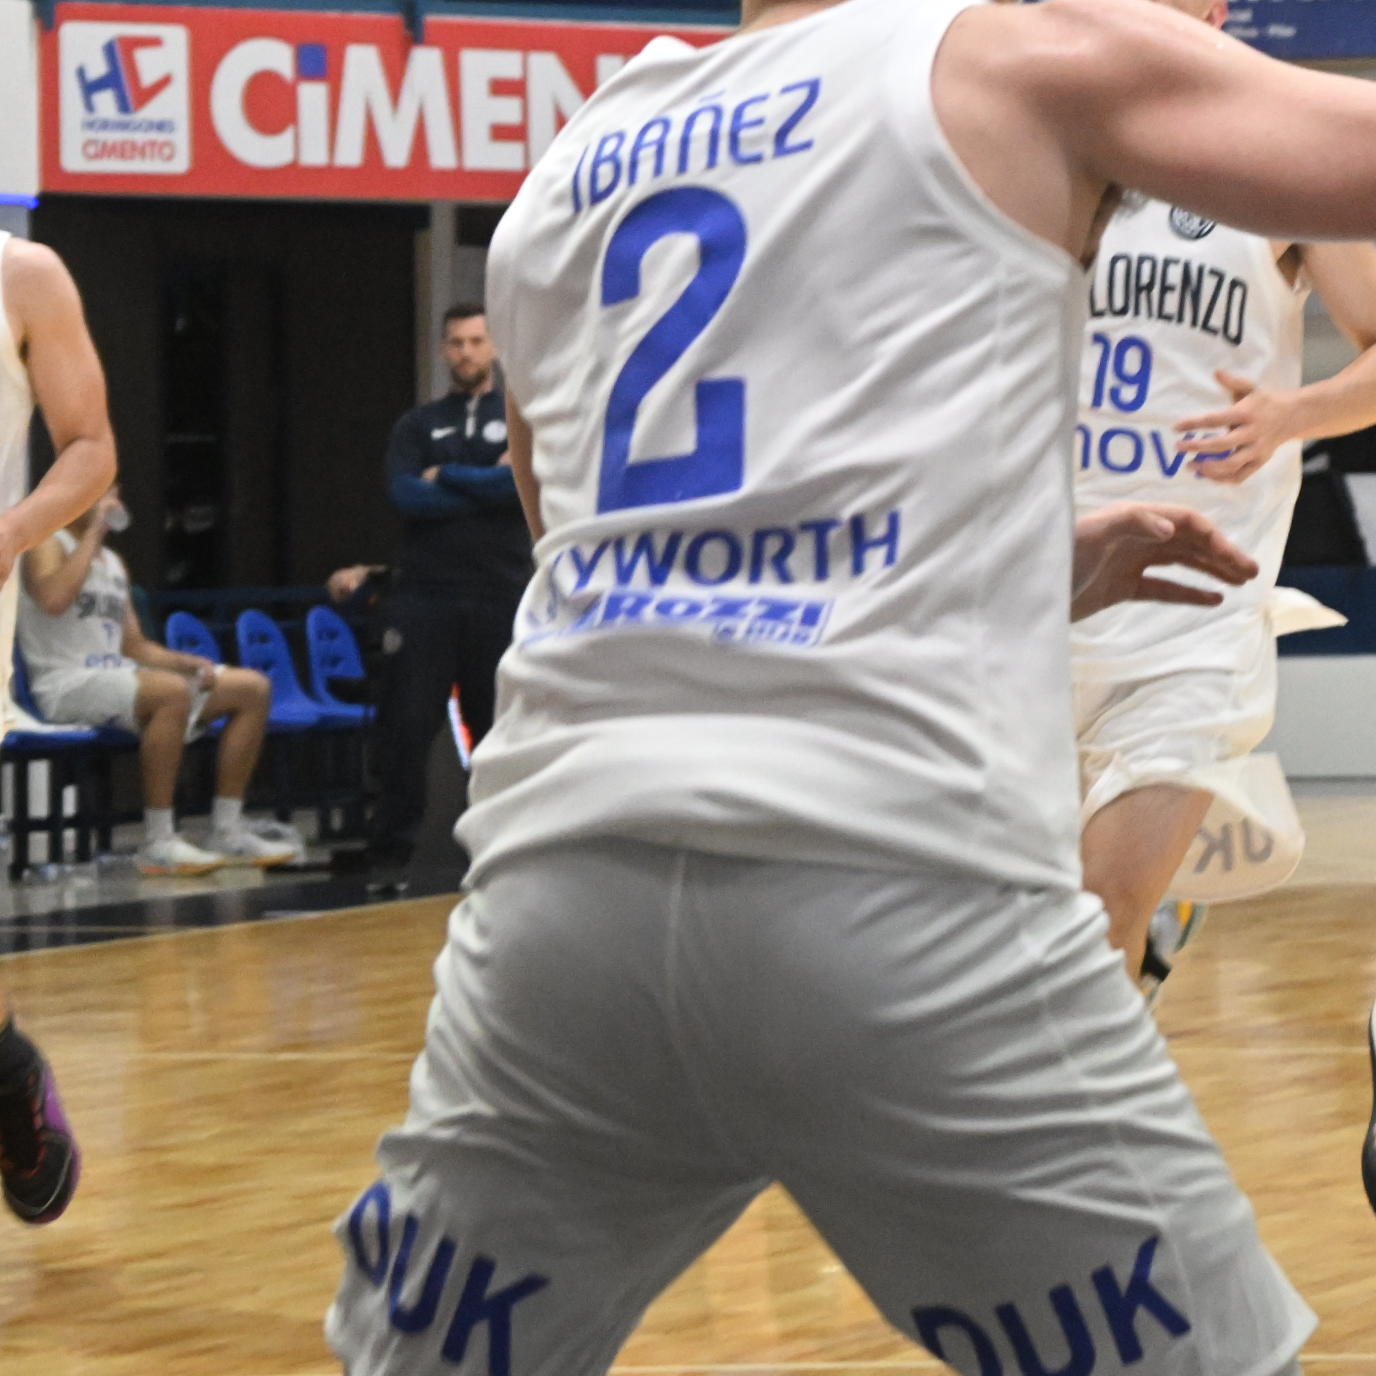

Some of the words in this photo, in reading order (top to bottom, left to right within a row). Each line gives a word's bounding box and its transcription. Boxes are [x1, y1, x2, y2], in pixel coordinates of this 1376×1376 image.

[210, 37, 628, 172] CiMEN
[570, 77, 823, 216] IBAÑEZ
[597, 186, 747, 516] 2
[1089, 253, 1248, 346] LORENZO
[1090, 331, 1154, 413] 19
